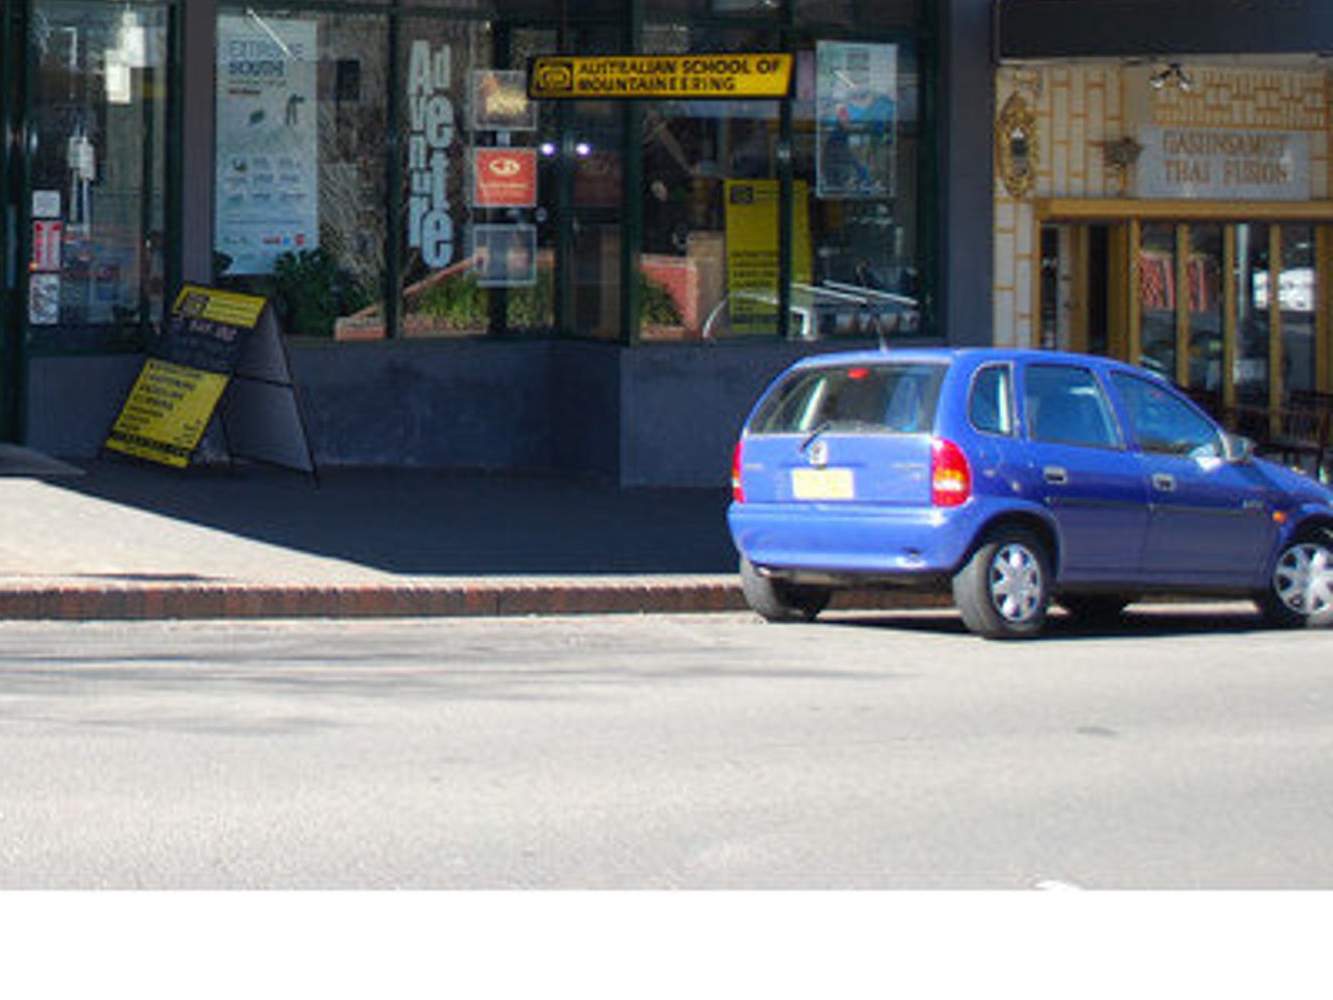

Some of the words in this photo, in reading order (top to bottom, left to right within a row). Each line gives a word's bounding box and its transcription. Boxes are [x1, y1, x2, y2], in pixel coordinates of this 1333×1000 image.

[579, 60, 677, 75] AUSTRALIAN
[681, 58, 751, 75] SCHOOL
[756, 59, 781, 73] OF
[578, 76, 736, 92] MOUNTAINEERING
